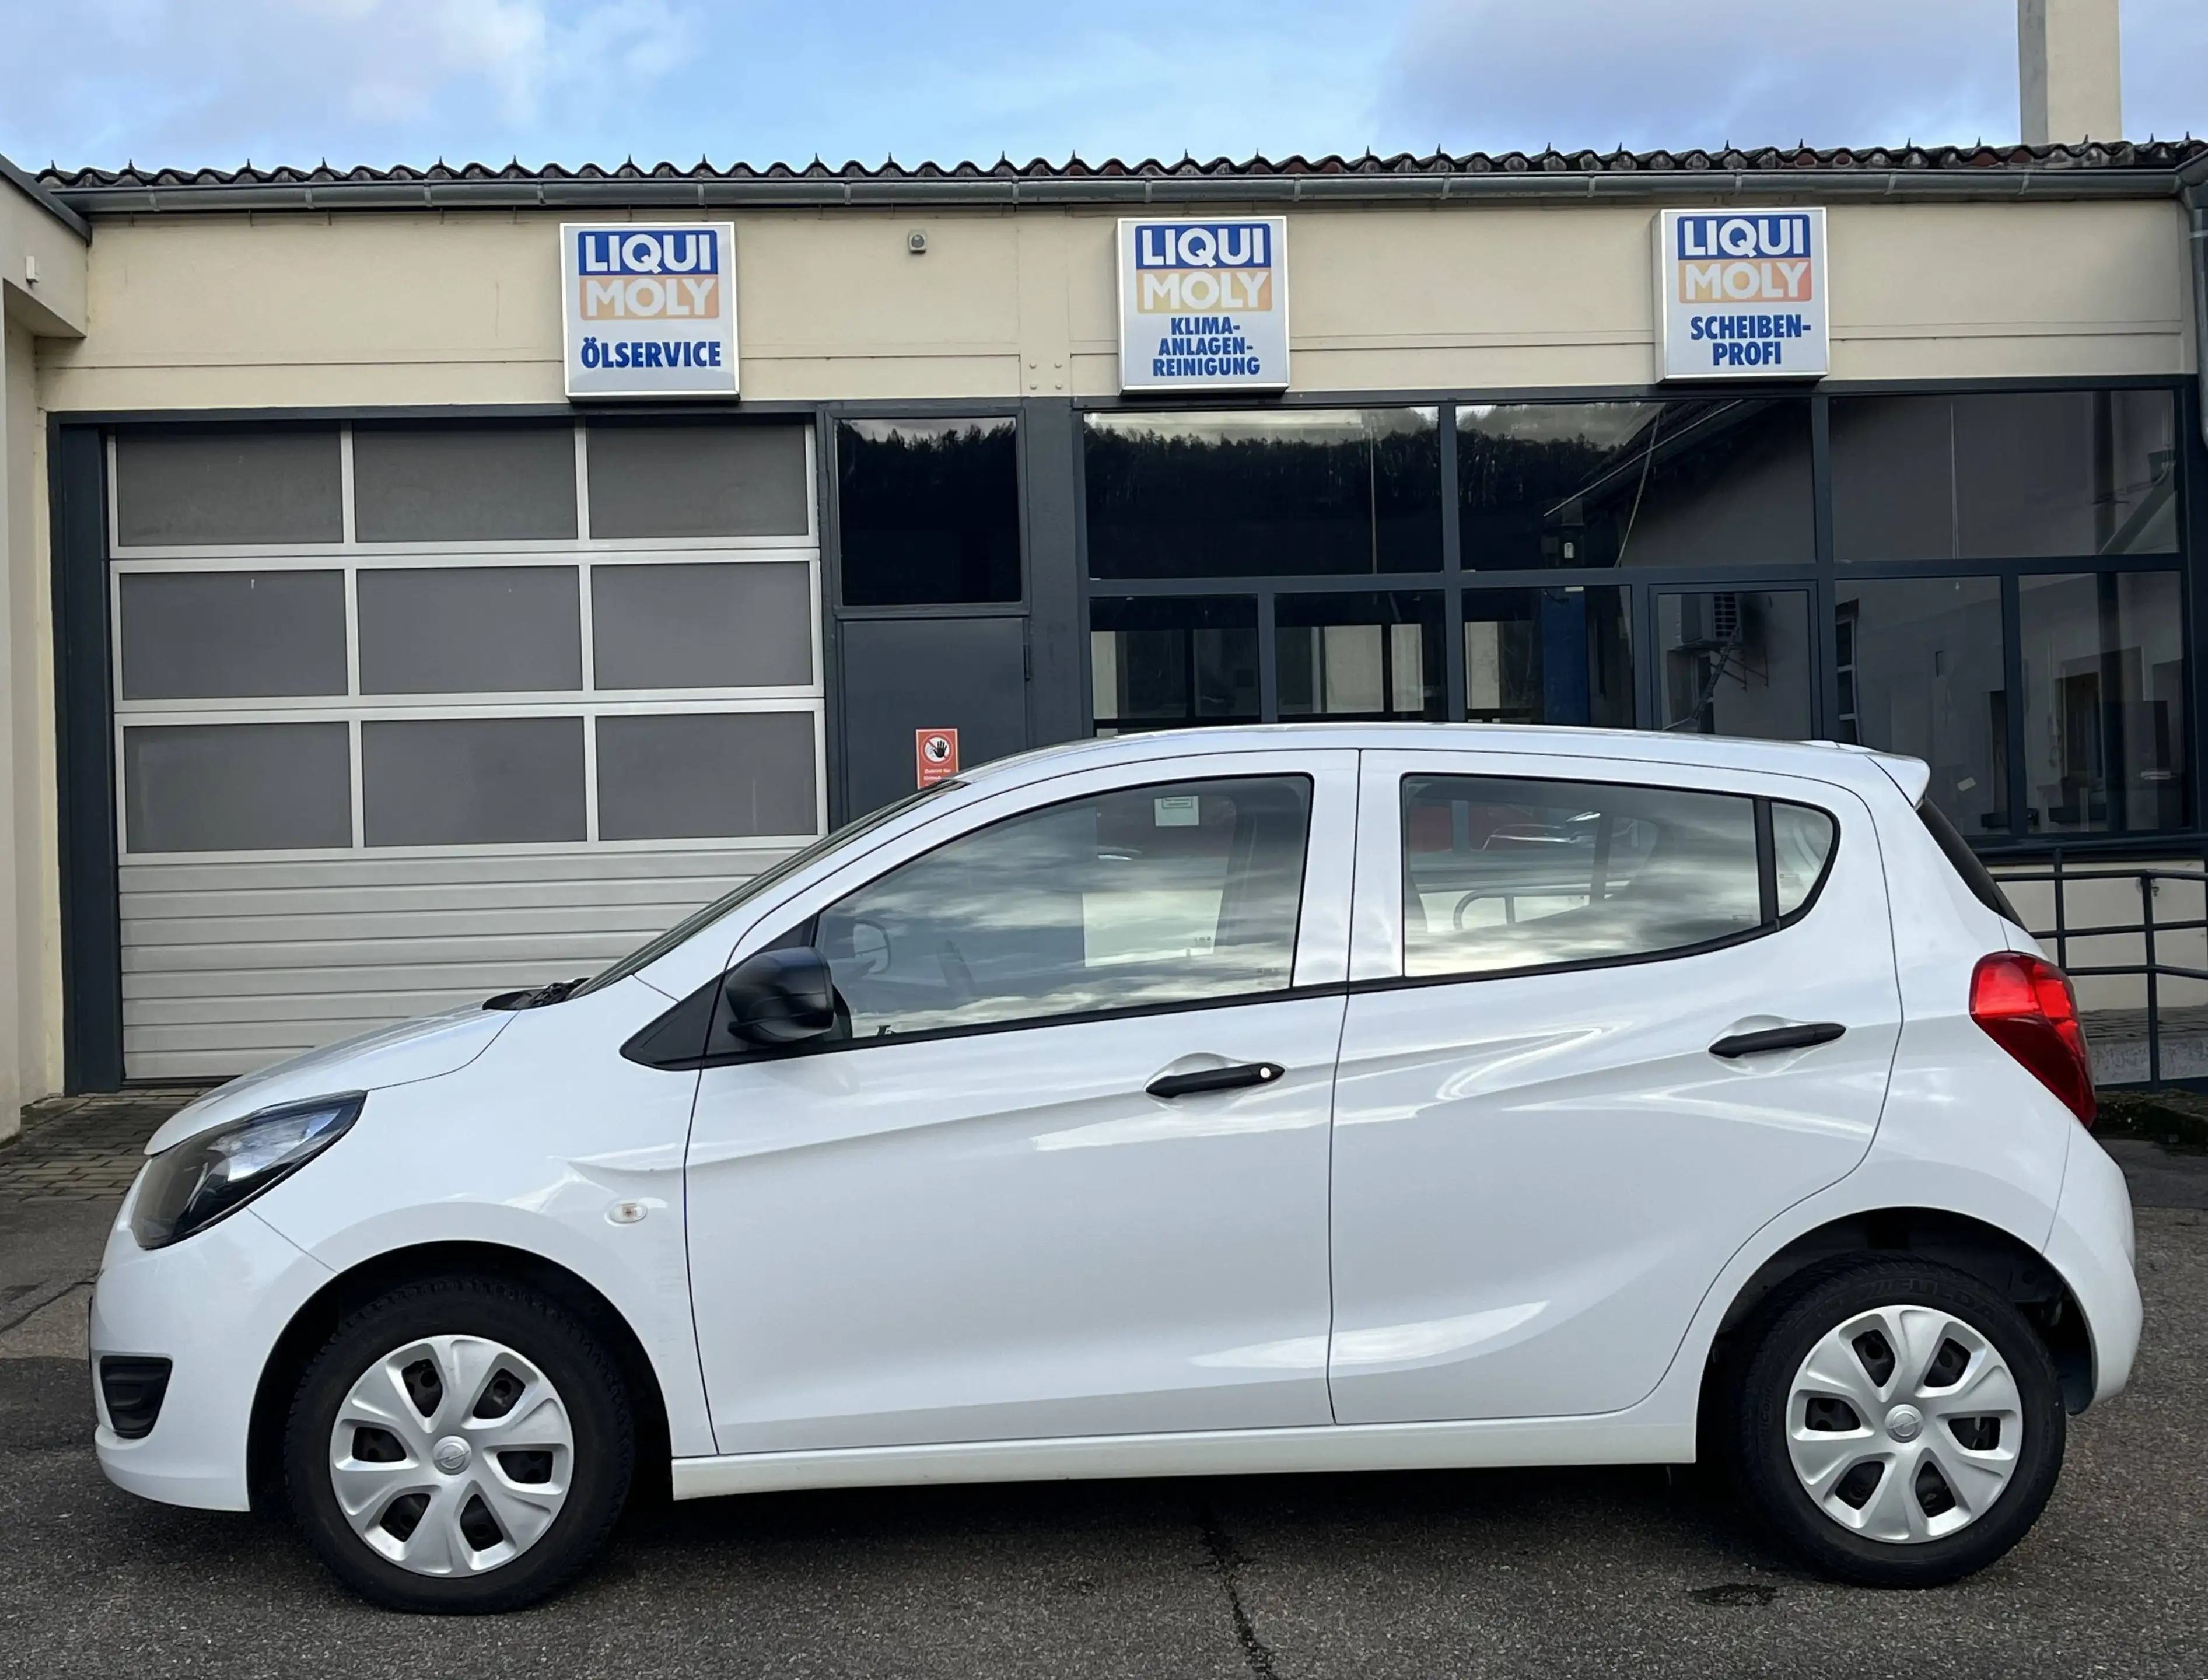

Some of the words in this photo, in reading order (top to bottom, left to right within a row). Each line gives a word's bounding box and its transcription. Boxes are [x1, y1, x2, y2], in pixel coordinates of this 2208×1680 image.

[585, 233, 712, 274] LIQUI
[1142, 227, 1264, 268] LIQUI
[1684, 218, 1804, 257] LIQUI
[586, 278, 717, 317] MOLY
[1143, 271, 1269, 310] MOLY
[1685, 261, 1808, 300] MOLY
[1171, 316, 1240, 335] KLIMA-
[1690, 314, 1811, 340] SCHEIBEN-
[580, 336, 722, 368] ÖLSERVICE
[1152, 356, 1261, 376] REINIGUNG
[1158, 337, 1253, 356] ANLAGEN-
[1712, 341, 1782, 366] PROFI
[1892, 1278, 1996, 1328] FULDA
